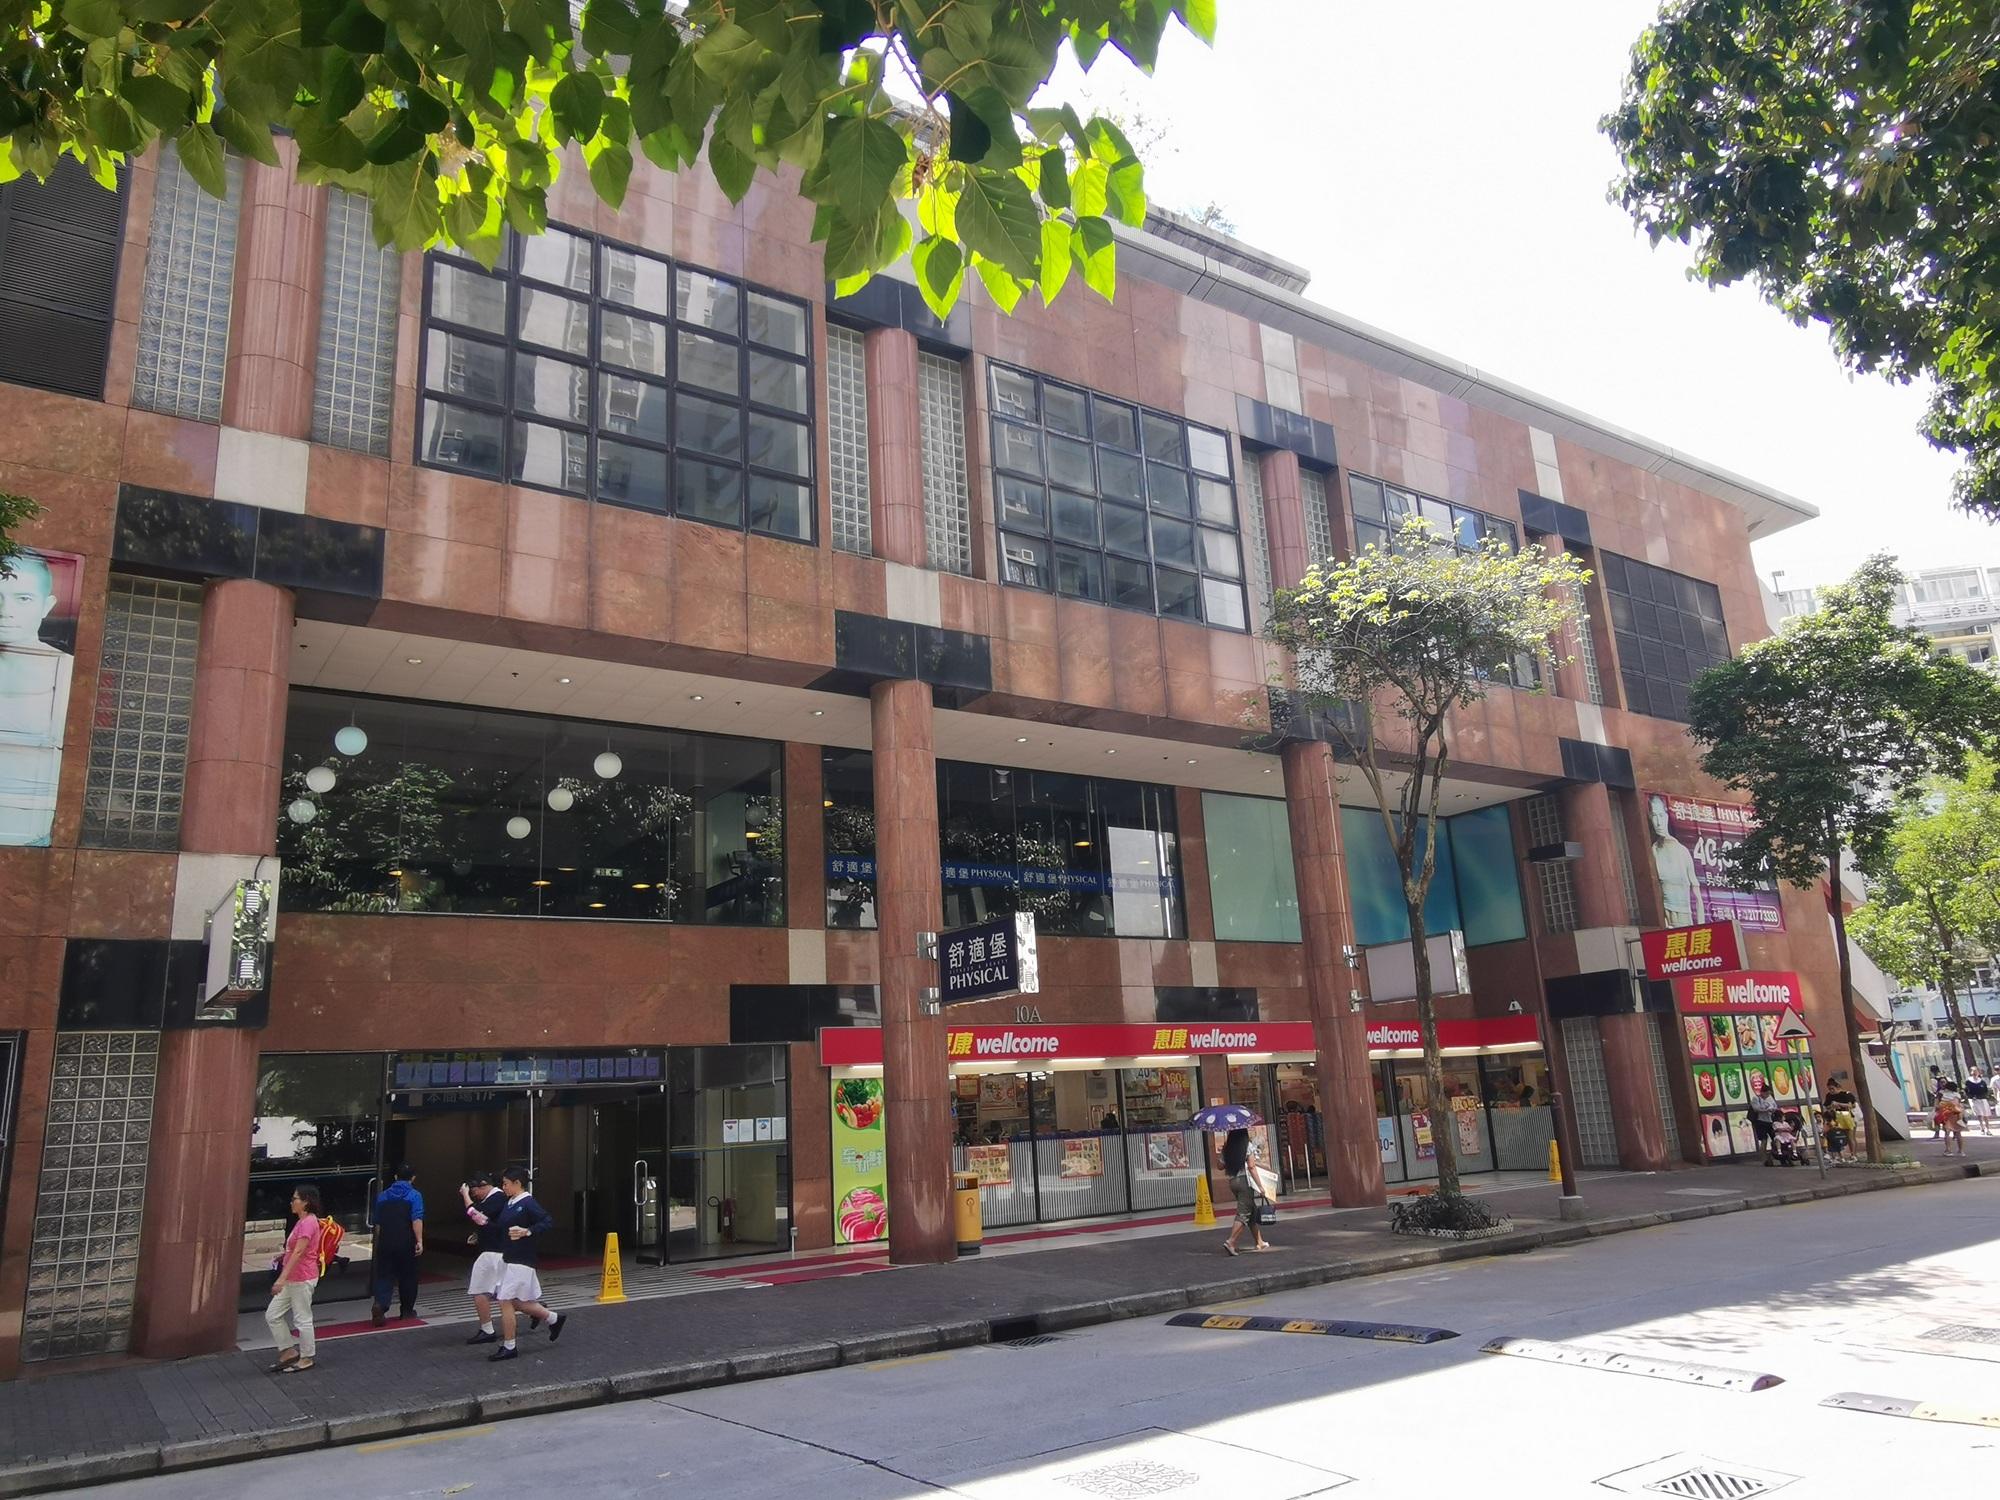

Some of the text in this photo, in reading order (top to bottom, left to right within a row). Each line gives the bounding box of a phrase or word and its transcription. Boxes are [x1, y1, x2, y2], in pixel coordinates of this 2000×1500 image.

[831, 859, 873, 875] 舒適堡
[941, 867, 1012, 880] 適堡 PHYSICAL
[948, 932, 1007, 969] 舒適堡
[1664, 928, 1712, 959] 惠康
[1661, 955, 1723, 974] wellcome
[949, 965, 1009, 990] PHYSICAL
[1693, 978, 1790, 1004] 惠康 wellcome
[1015, 1005, 1042, 1023] 10A
[976, 1032, 1059, 1054] wellcome
[1153, 1028, 1257, 1050] 惠康 wellcome
[1366, 1026, 1419, 1044] wellcome
